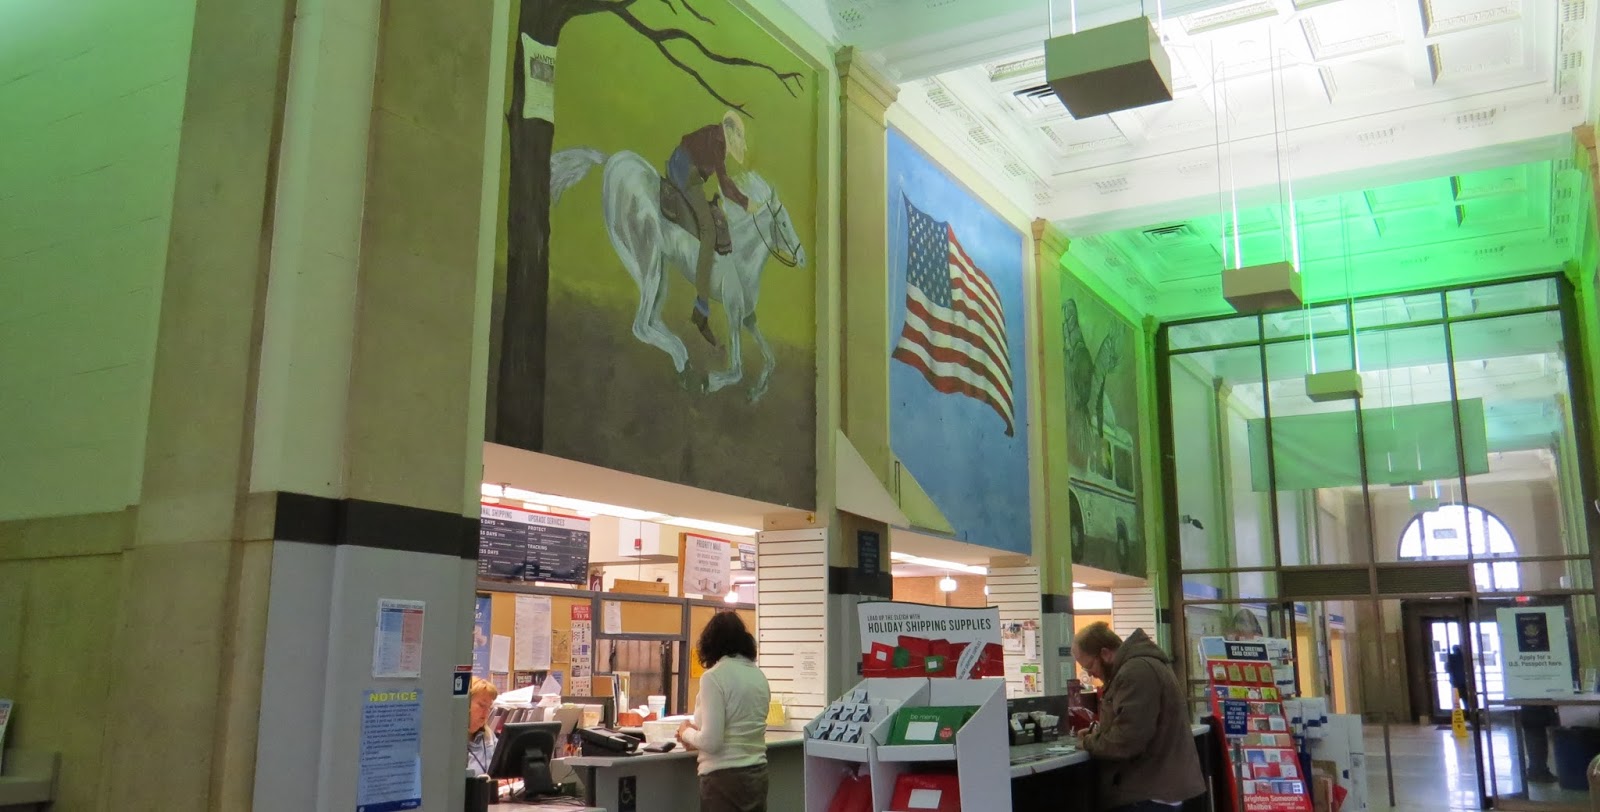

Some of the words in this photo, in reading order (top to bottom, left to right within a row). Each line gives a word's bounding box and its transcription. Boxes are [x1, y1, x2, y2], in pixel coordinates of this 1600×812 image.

[491, 509, 513, 520] SHIPPING
[528, 514, 547, 525] UPGRADE
[546, 517, 566, 527] SERVICES
[868, 621, 903, 633] HOLIDAY
[906, 619, 947, 632] SHIPPING
[949, 618, 992, 631] SUPPLIES
[369, 691, 418, 702] NOTICE
[919, 714, 940, 722] merry
[1246, 803, 1272, 811] Mailbox
